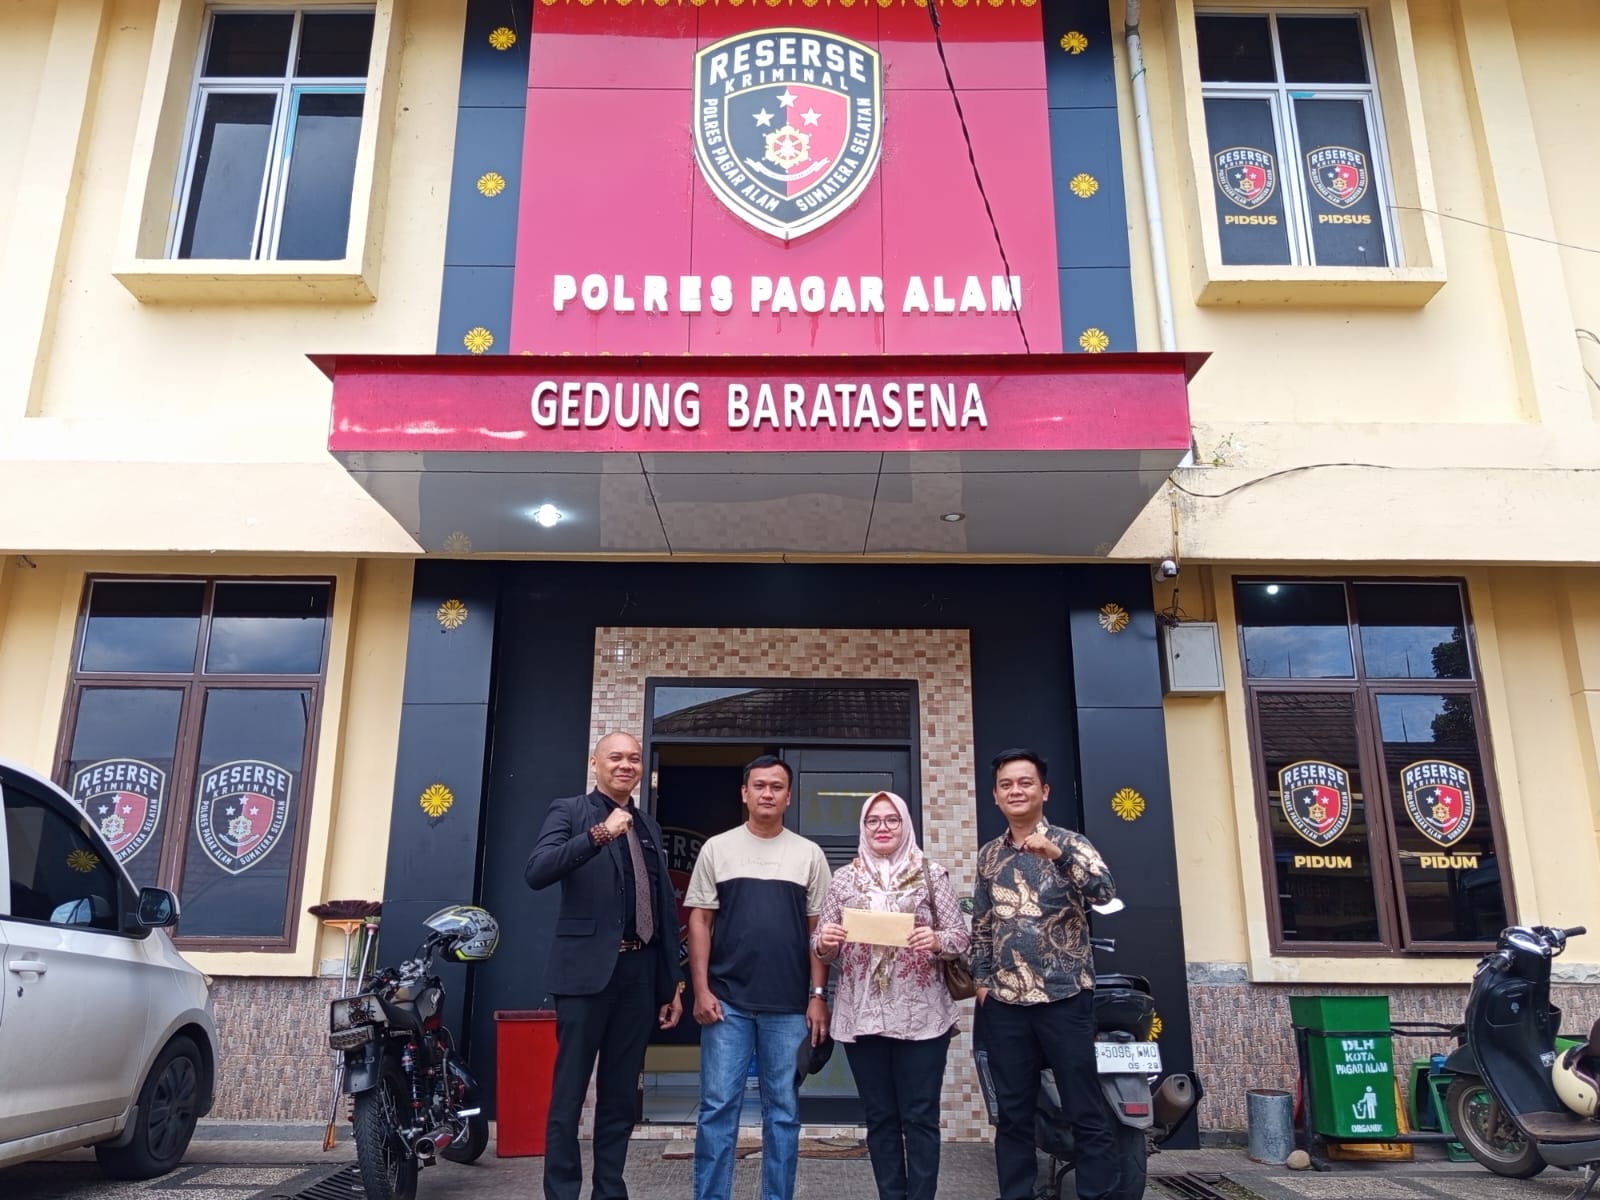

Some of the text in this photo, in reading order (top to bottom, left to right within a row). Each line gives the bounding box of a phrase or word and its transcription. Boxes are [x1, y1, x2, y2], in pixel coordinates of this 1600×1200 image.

[709, 37, 865, 85] RESERSE
[725, 68, 848, 94] KRIMINAL
[703, 98, 780, 212] POLRES PAGAR ALAM
[796, 98, 871, 212] SUMATERA SELATAN
[1219, 150, 1269, 166] RESERSE
[1311, 150, 1362, 165] RESERSE
[1225, 215, 1278, 225] PIDSUS
[1318, 214, 1371, 224] PIDSUS
[552, 274, 1022, 313] POLRES PAGAR ALAM
[531, 380, 989, 429] GEDUNG BARATASENA
[80, 765, 159, 791] RESERSE
[206, 766, 286, 793] RESERSE
[1284, 765, 1344, 786] RESERSE
[1406, 764, 1467, 786] RESERSE
[86, 782, 149, 797] KRIMINAL
[213, 784, 276, 798] KRIMINAL
[200, 800, 210, 828] POLRES
[118, 799, 158, 860] UMATERA SELATAN
[239, 800, 286, 865] SUMATERA SELATAN
[1295, 855, 1352, 869] PIDUM
[1420, 855, 1478, 869] PIDUM
[1342, 1039, 1375, 1051] DLH
[1345, 1052, 1375, 1062] KOTA
[1336, 1063, 1363, 1075] PAGAR
